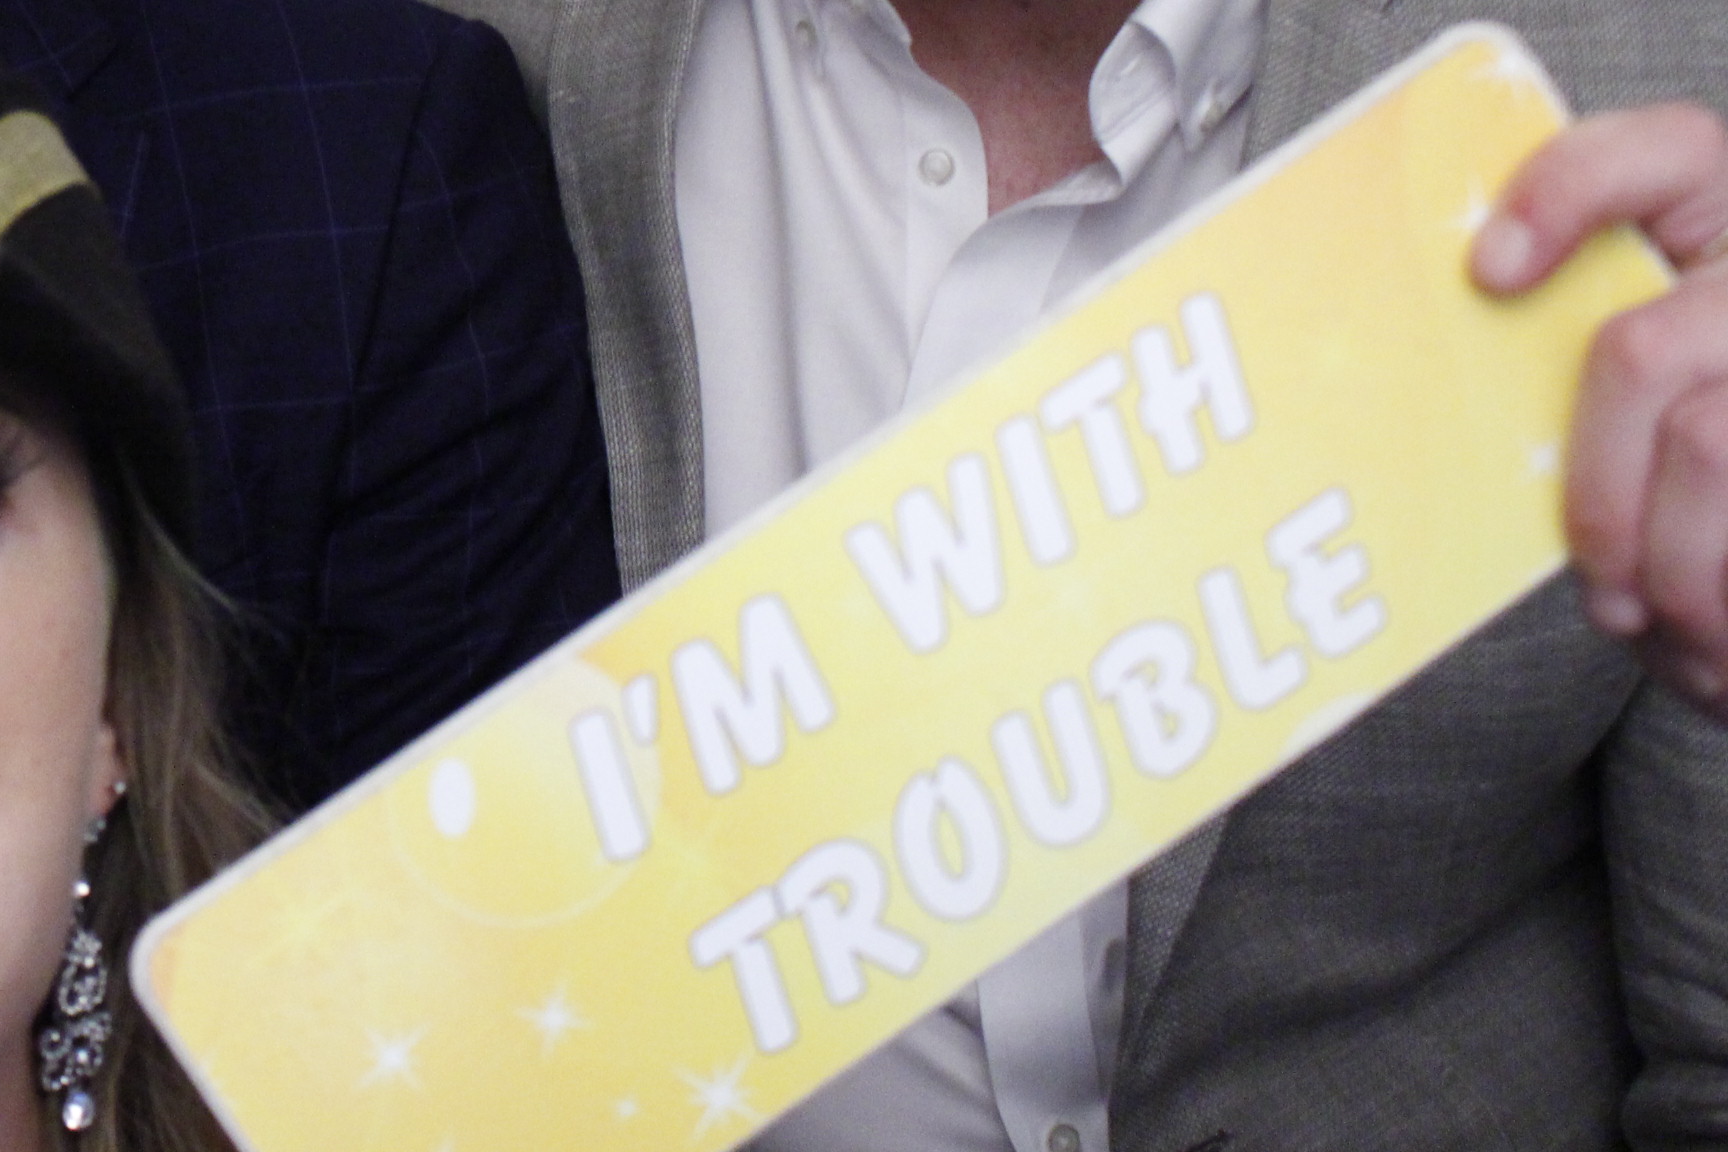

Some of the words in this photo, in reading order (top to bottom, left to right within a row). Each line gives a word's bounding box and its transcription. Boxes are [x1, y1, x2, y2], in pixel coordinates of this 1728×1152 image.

[568, 595, 834, 862] I'M
[846, 293, 1256, 654] WITH
[691, 489, 1387, 1053] TROUBLE
